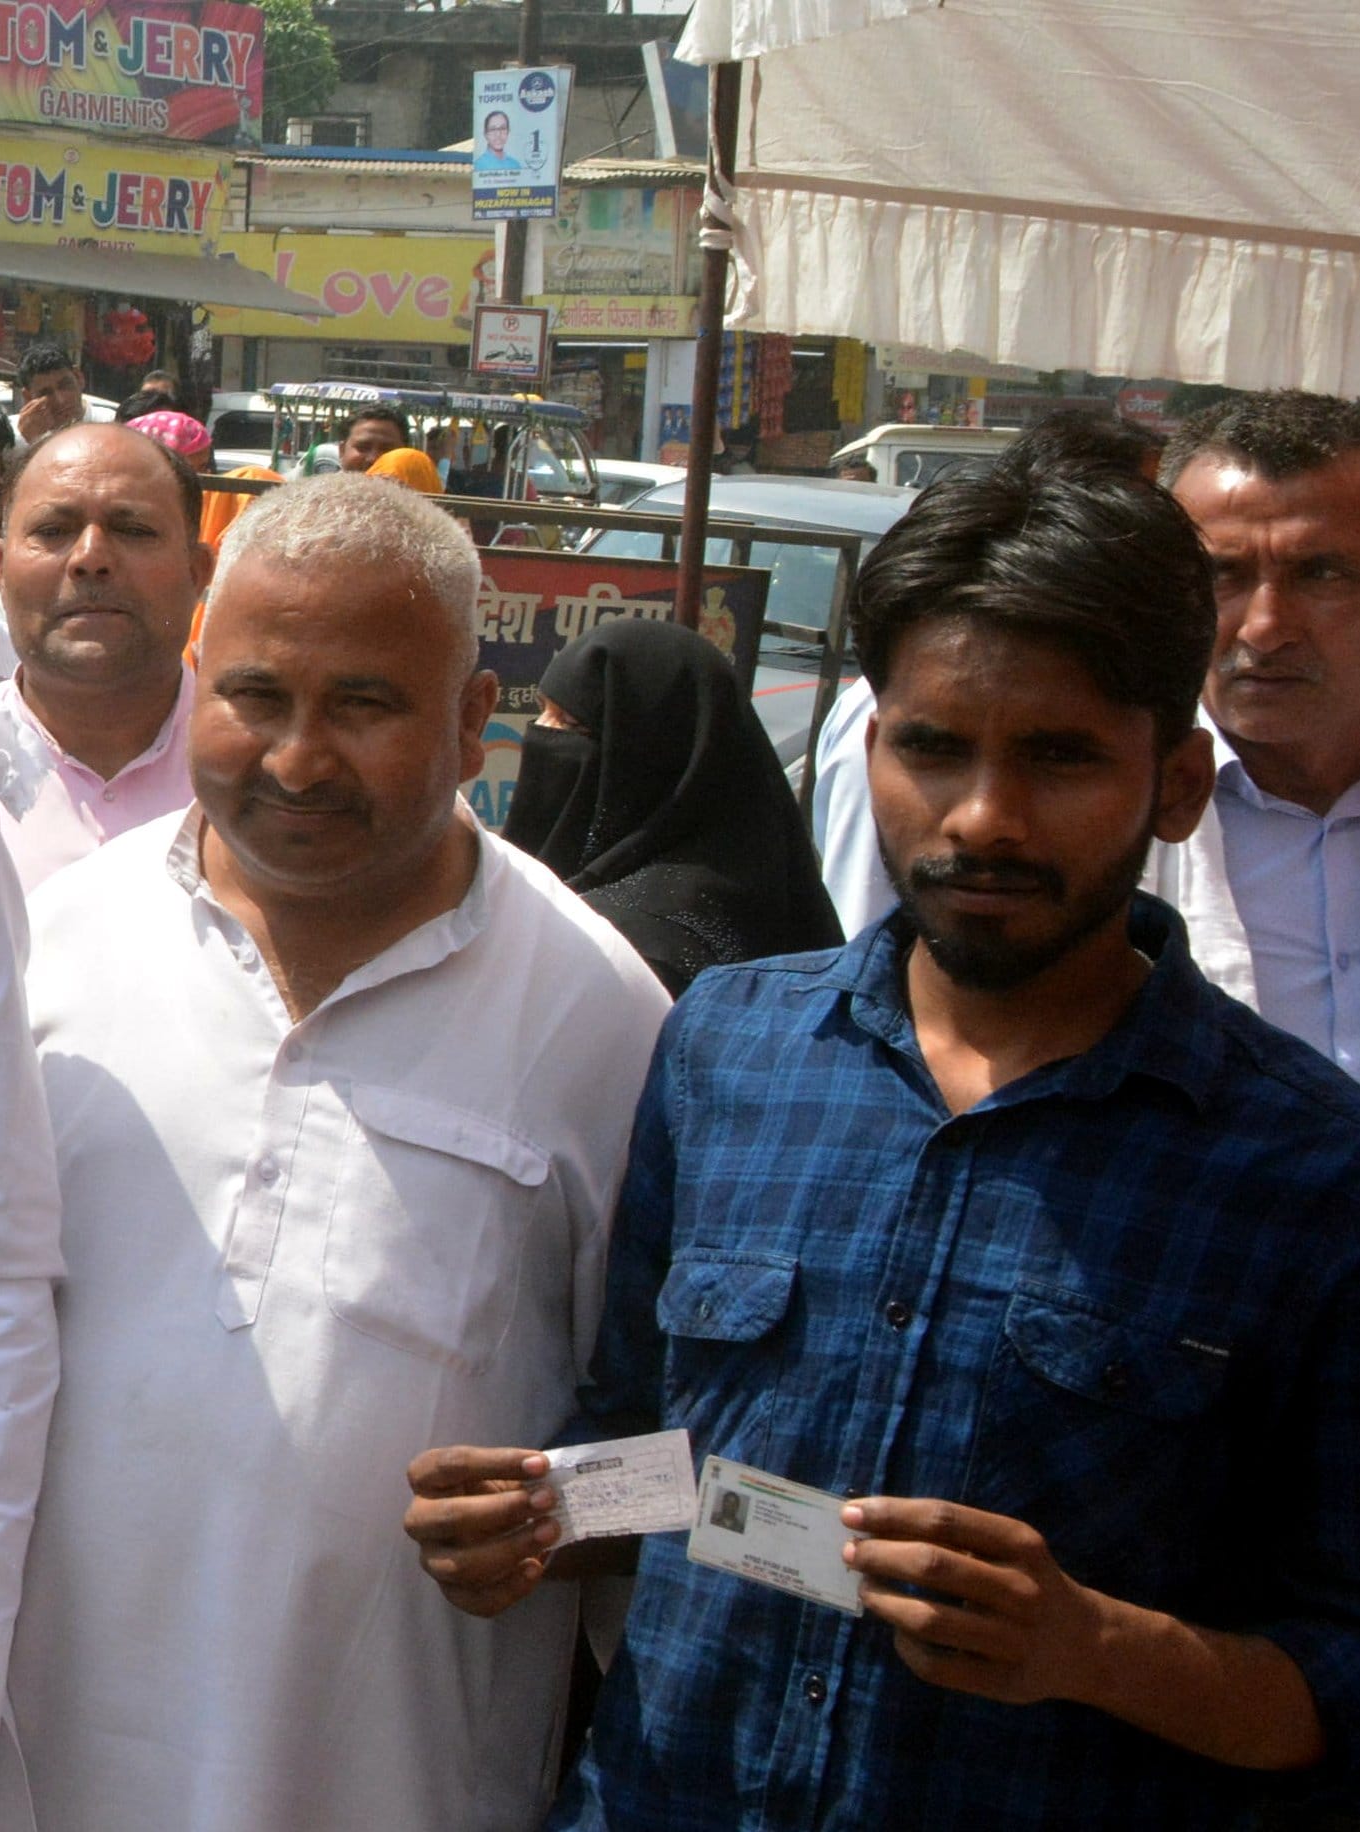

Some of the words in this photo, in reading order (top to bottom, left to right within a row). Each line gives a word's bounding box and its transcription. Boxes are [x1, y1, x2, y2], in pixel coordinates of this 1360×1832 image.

[93, 29, 111, 58] &
[116, 16, 256, 90] JERRY
[39, 85, 169, 131] GARMENTS
[70, 183, 86, 211] &
[90, 170, 214, 235] JERRY
